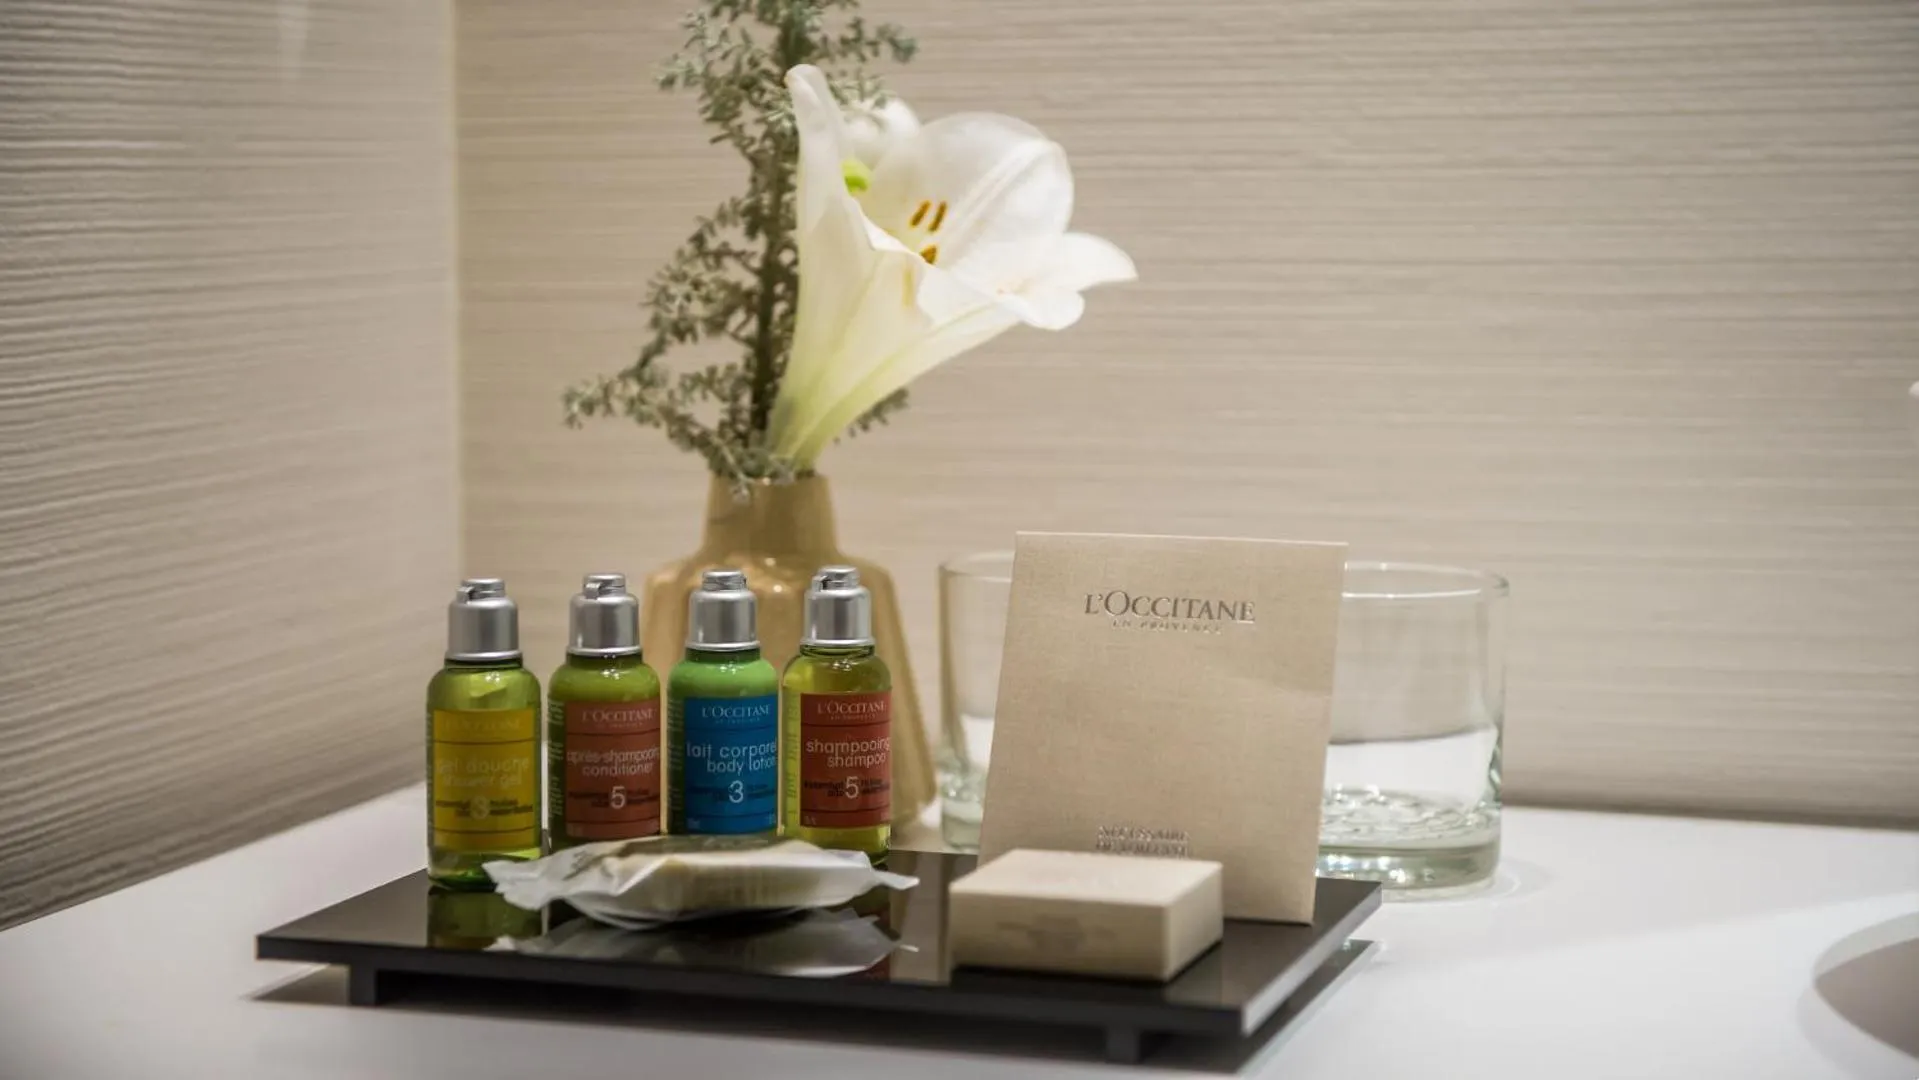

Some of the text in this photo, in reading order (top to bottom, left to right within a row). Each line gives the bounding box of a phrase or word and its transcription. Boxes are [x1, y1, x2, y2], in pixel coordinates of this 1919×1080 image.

[1085, 590, 1256, 622] L'OCCITANE
[686, 742, 712, 758] lait
[826, 752, 886, 769] shampoo
[582, 761, 654, 777] conditioner
[706, 757, 744, 777] body
[610, 785, 627, 810] 5
[728, 779, 745, 804] 3
[844, 776, 860, 799] 5
